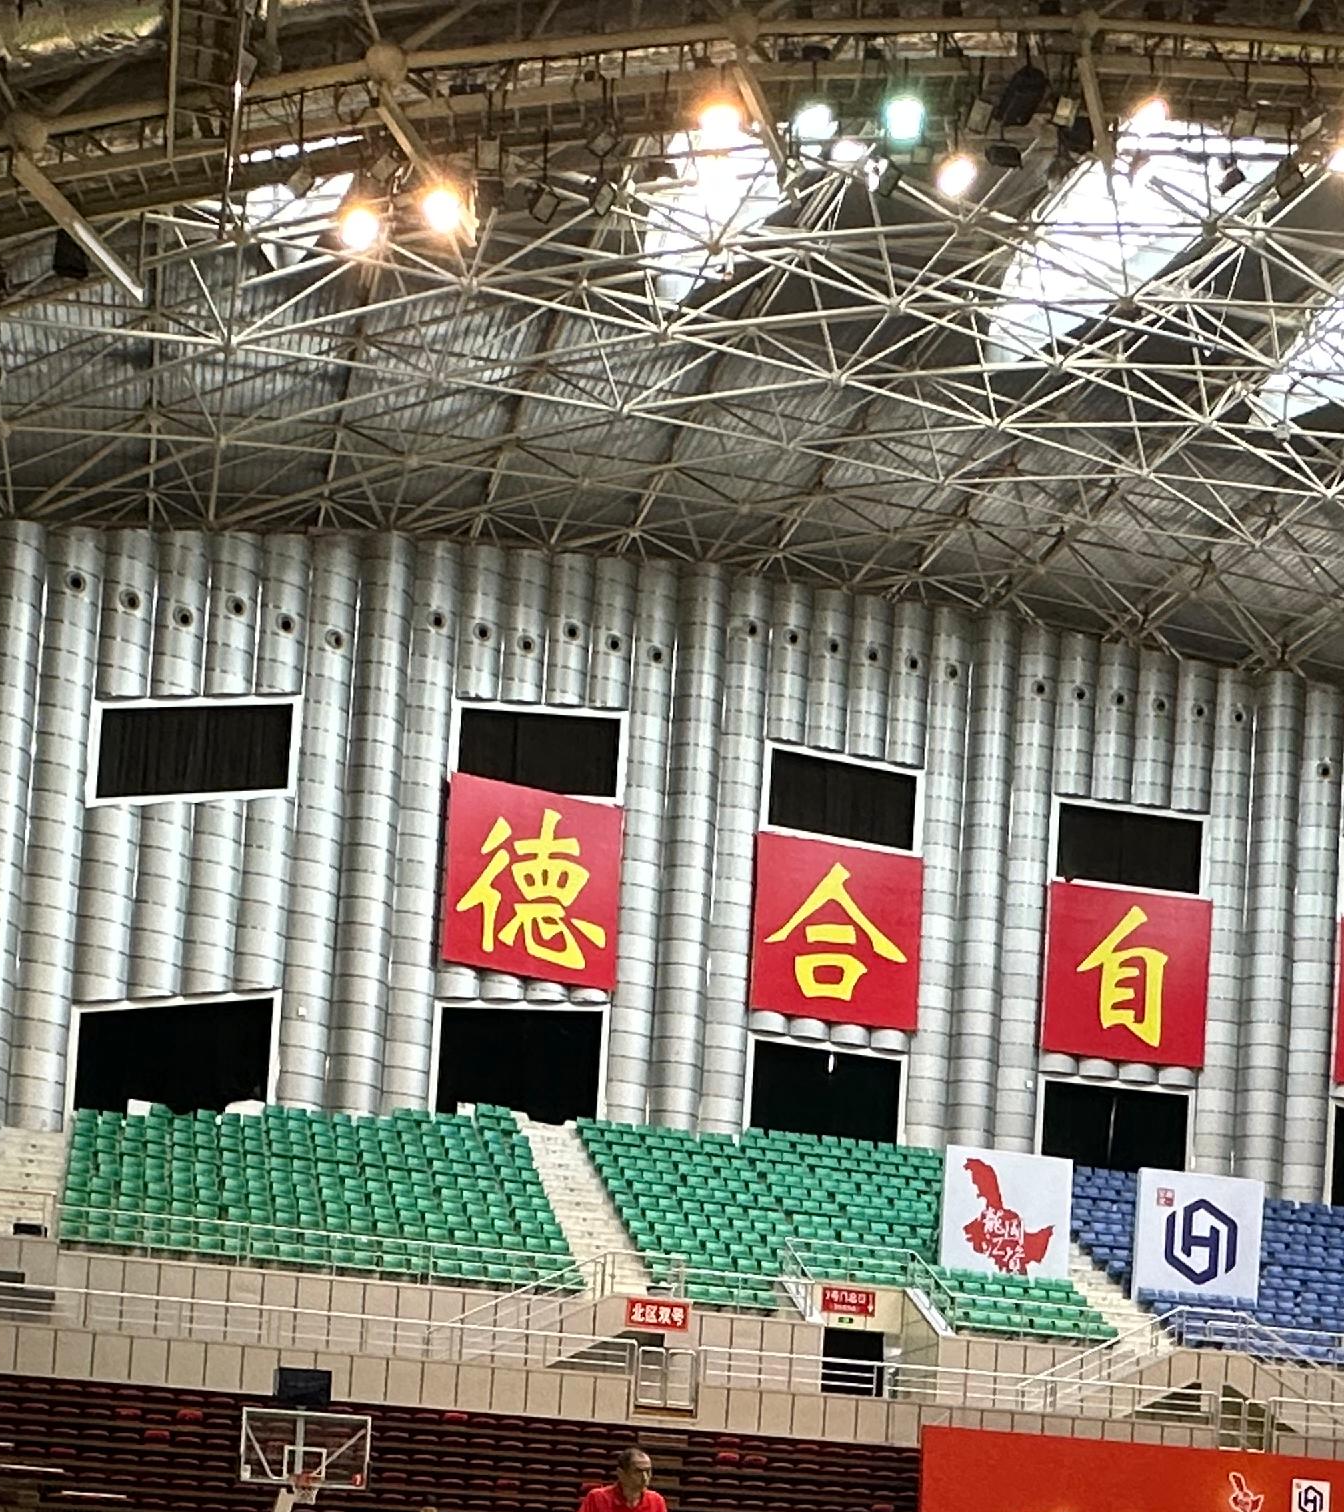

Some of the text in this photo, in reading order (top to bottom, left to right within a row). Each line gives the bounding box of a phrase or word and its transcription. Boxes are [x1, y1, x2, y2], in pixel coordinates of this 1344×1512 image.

[455, 808, 605, 969] 德
[765, 860, 906, 1002] 合
[1077, 904, 1169, 1048] 自
[630, 1302, 684, 1326] 北区双号
